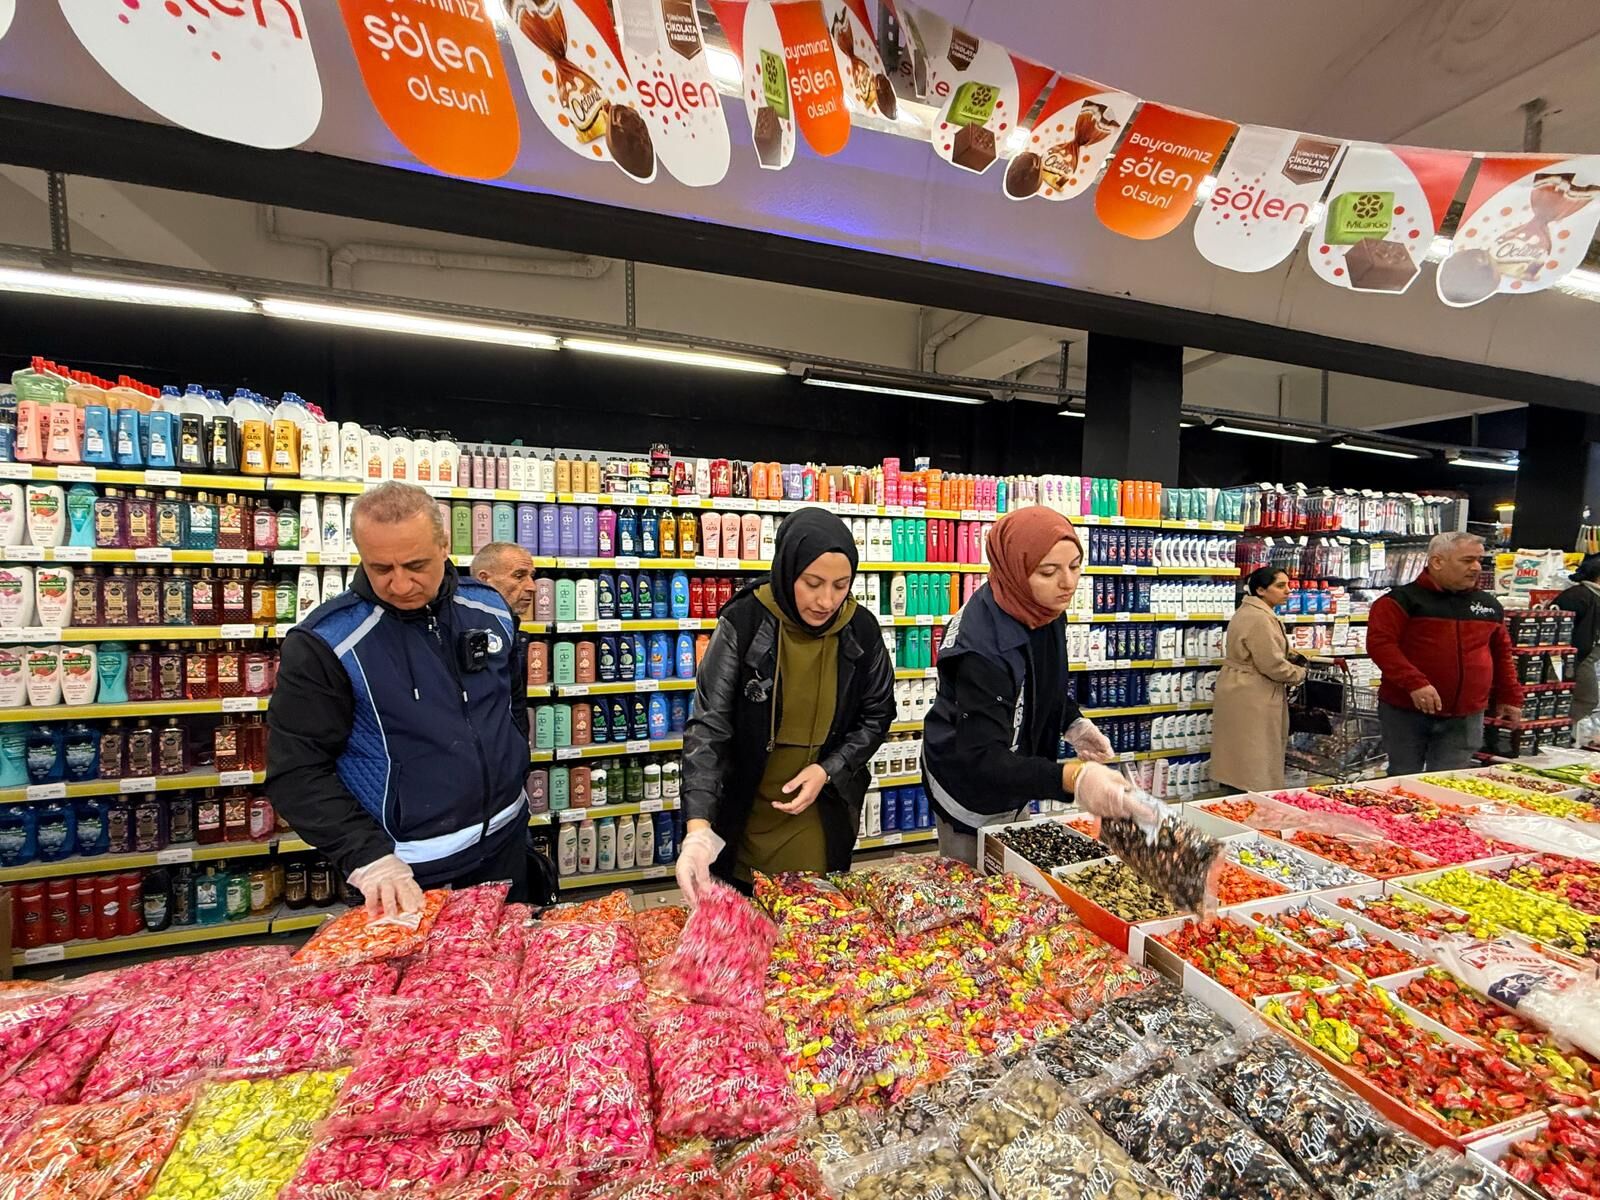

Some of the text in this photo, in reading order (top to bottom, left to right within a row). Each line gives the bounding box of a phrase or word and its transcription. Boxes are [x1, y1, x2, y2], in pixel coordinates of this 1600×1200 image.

[363, 12, 493, 79] şölen
[784, 39, 829, 65] ayramınız
[407, 75, 490, 115] olsun!
[791, 67, 836, 102] şölen
[807, 96, 837, 119] olsun!
[1129, 132, 1213, 165] Bayramınız
[1288, 155, 1330, 169] ÇİKOLATA
[1119, 156, 1193, 191] şölen
[1121, 184, 1173, 209] olsun!
